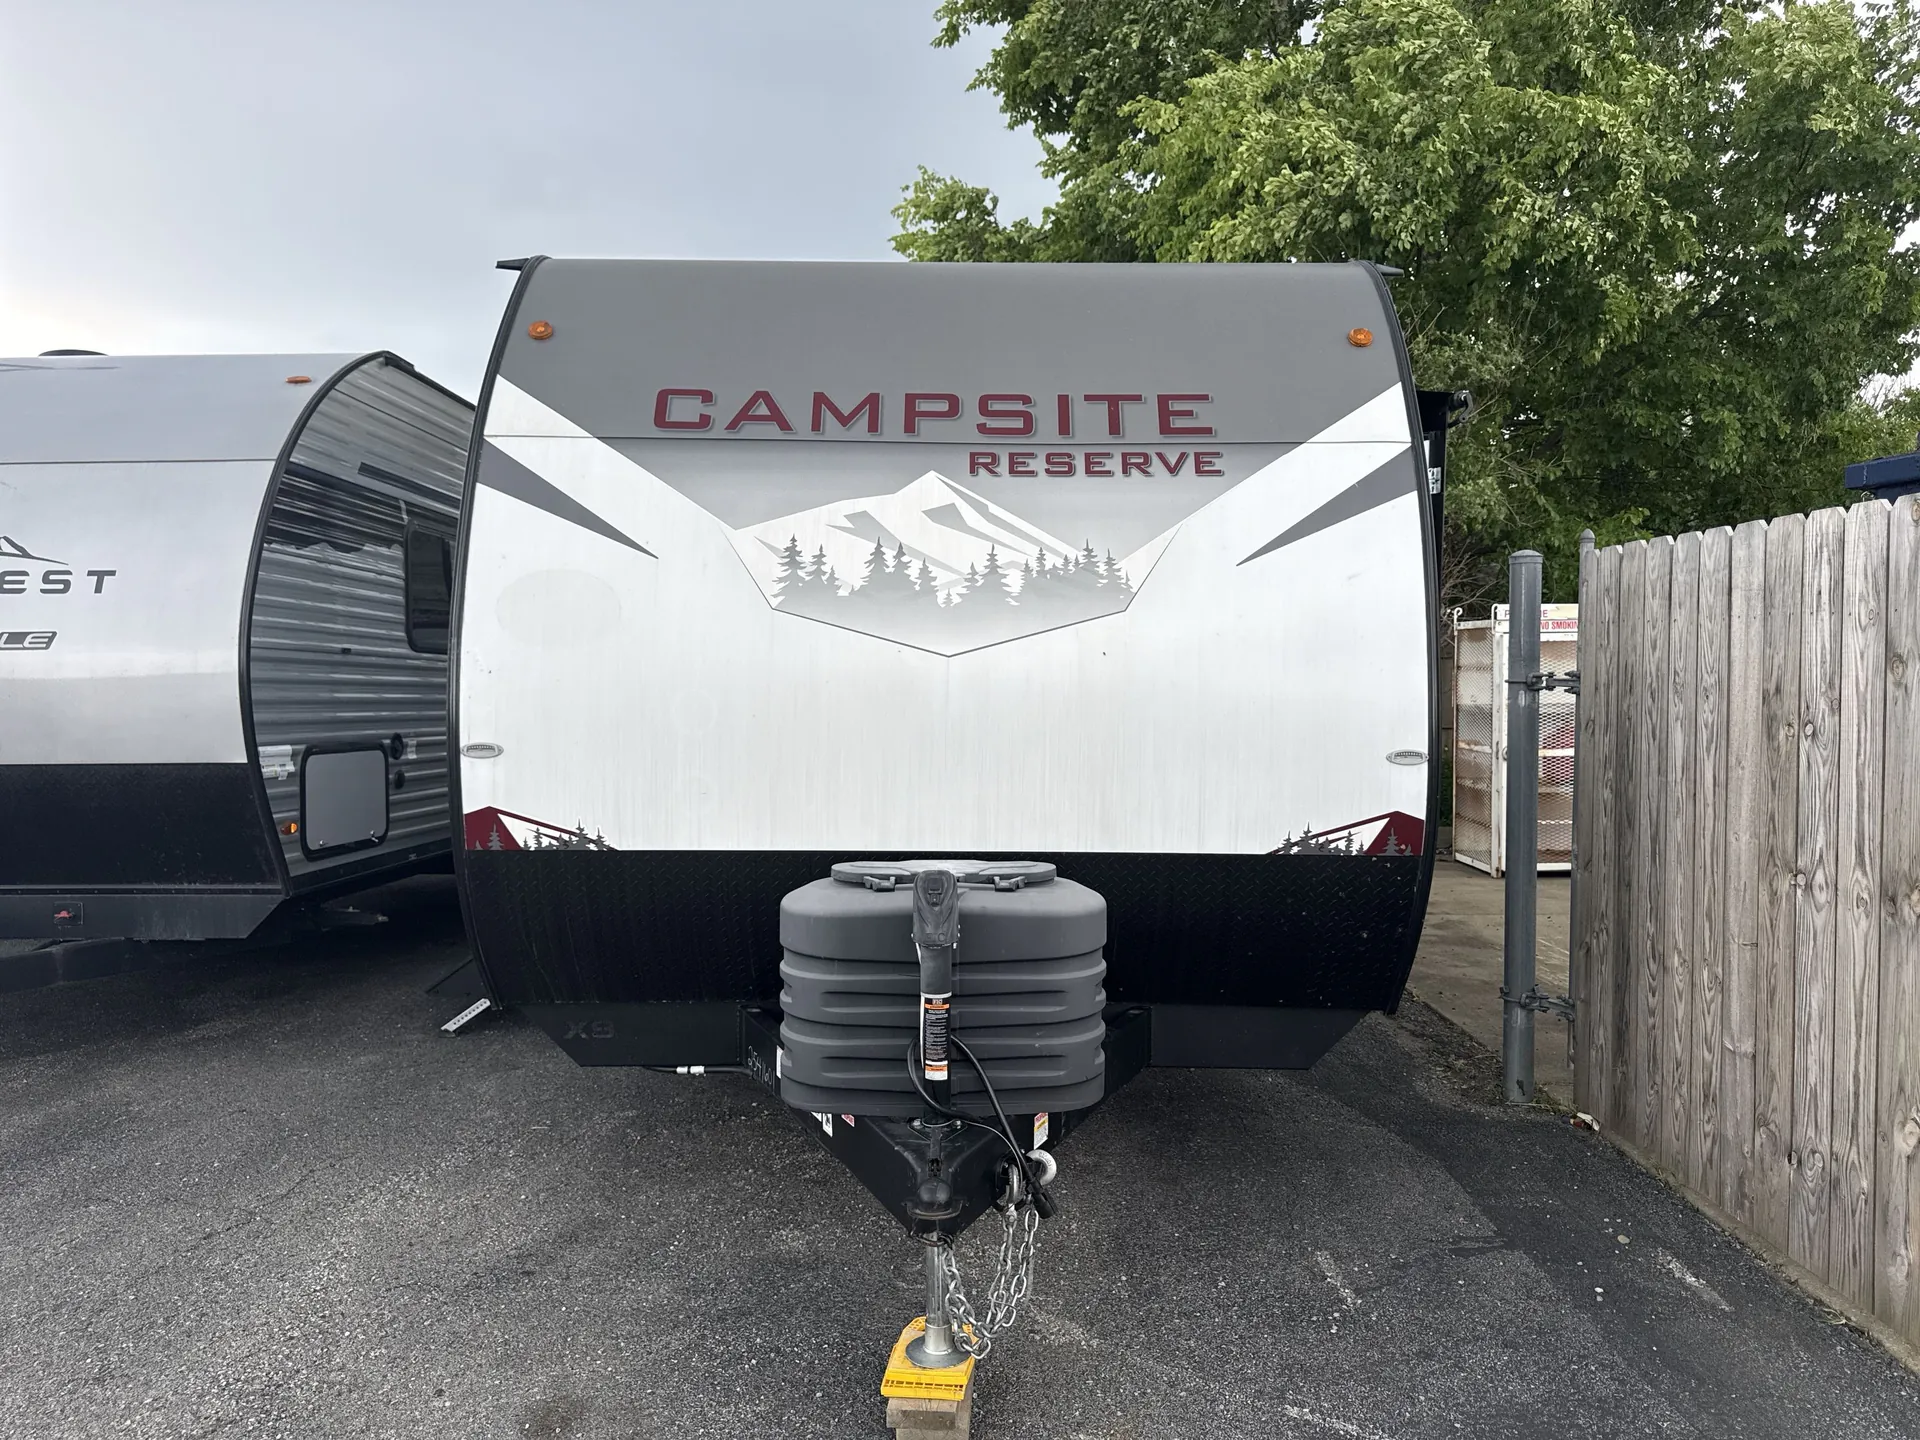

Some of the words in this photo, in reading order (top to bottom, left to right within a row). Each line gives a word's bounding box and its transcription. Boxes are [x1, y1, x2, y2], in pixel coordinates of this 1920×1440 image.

[653, 388, 1216, 437] CAMPSITE
[969, 451, 1224, 476] RESERVE
[0, 569, 118, 595] EST
